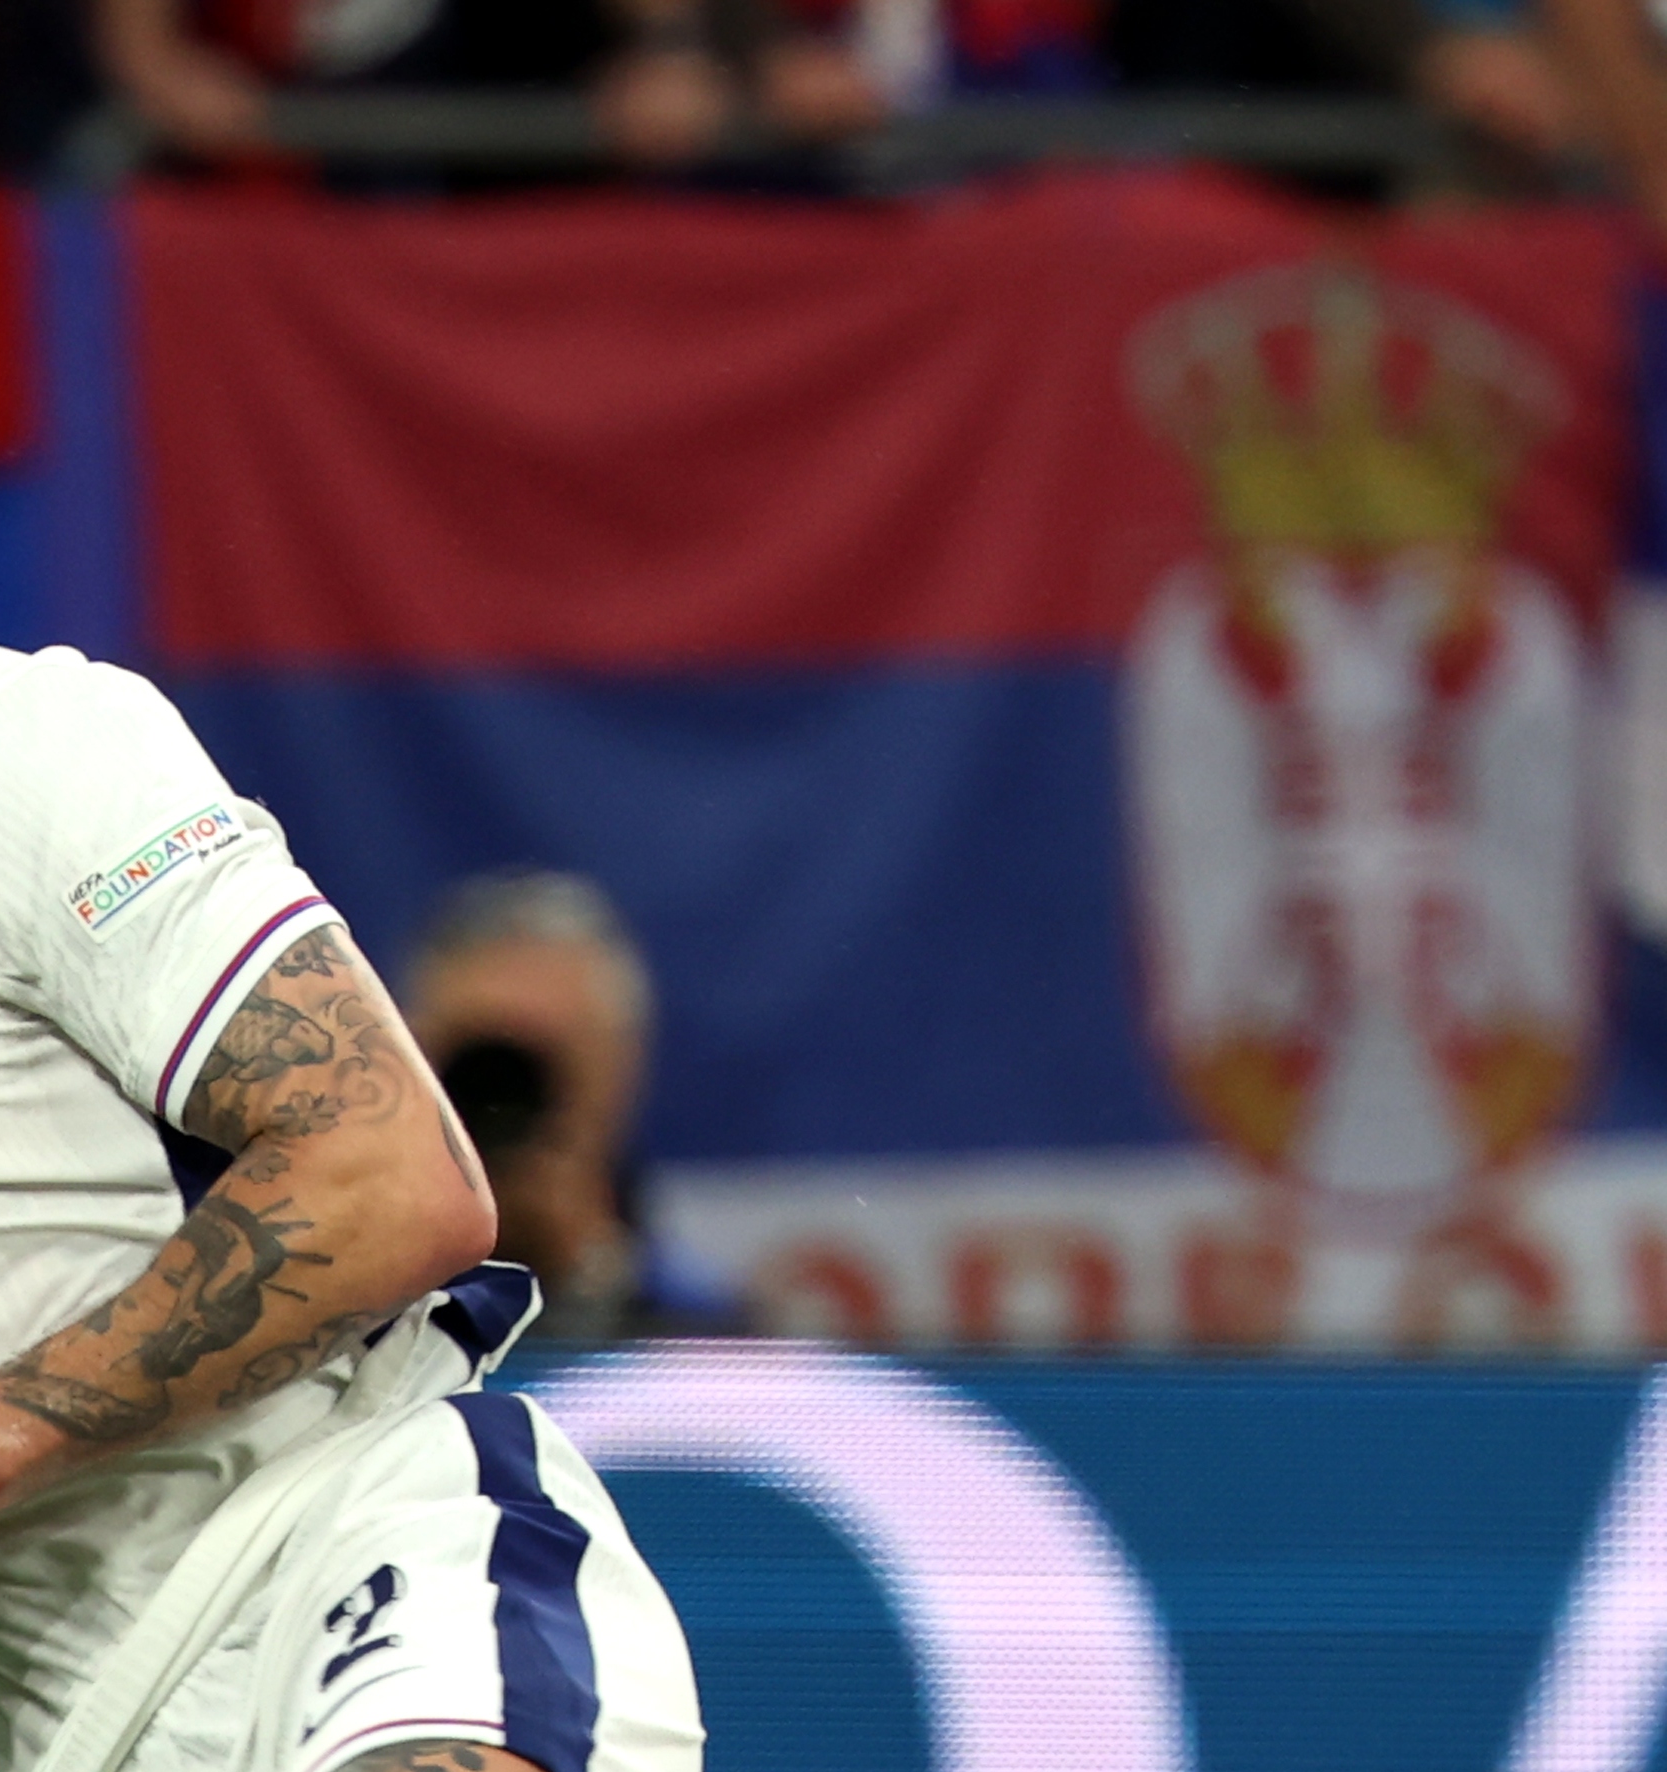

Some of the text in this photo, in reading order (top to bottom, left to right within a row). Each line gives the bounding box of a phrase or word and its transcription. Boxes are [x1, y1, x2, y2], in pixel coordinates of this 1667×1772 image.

[68, 871, 105, 905] UEFA
[77, 809, 232, 924] FOUNDATION
[318, 1563, 409, 1692] 2
